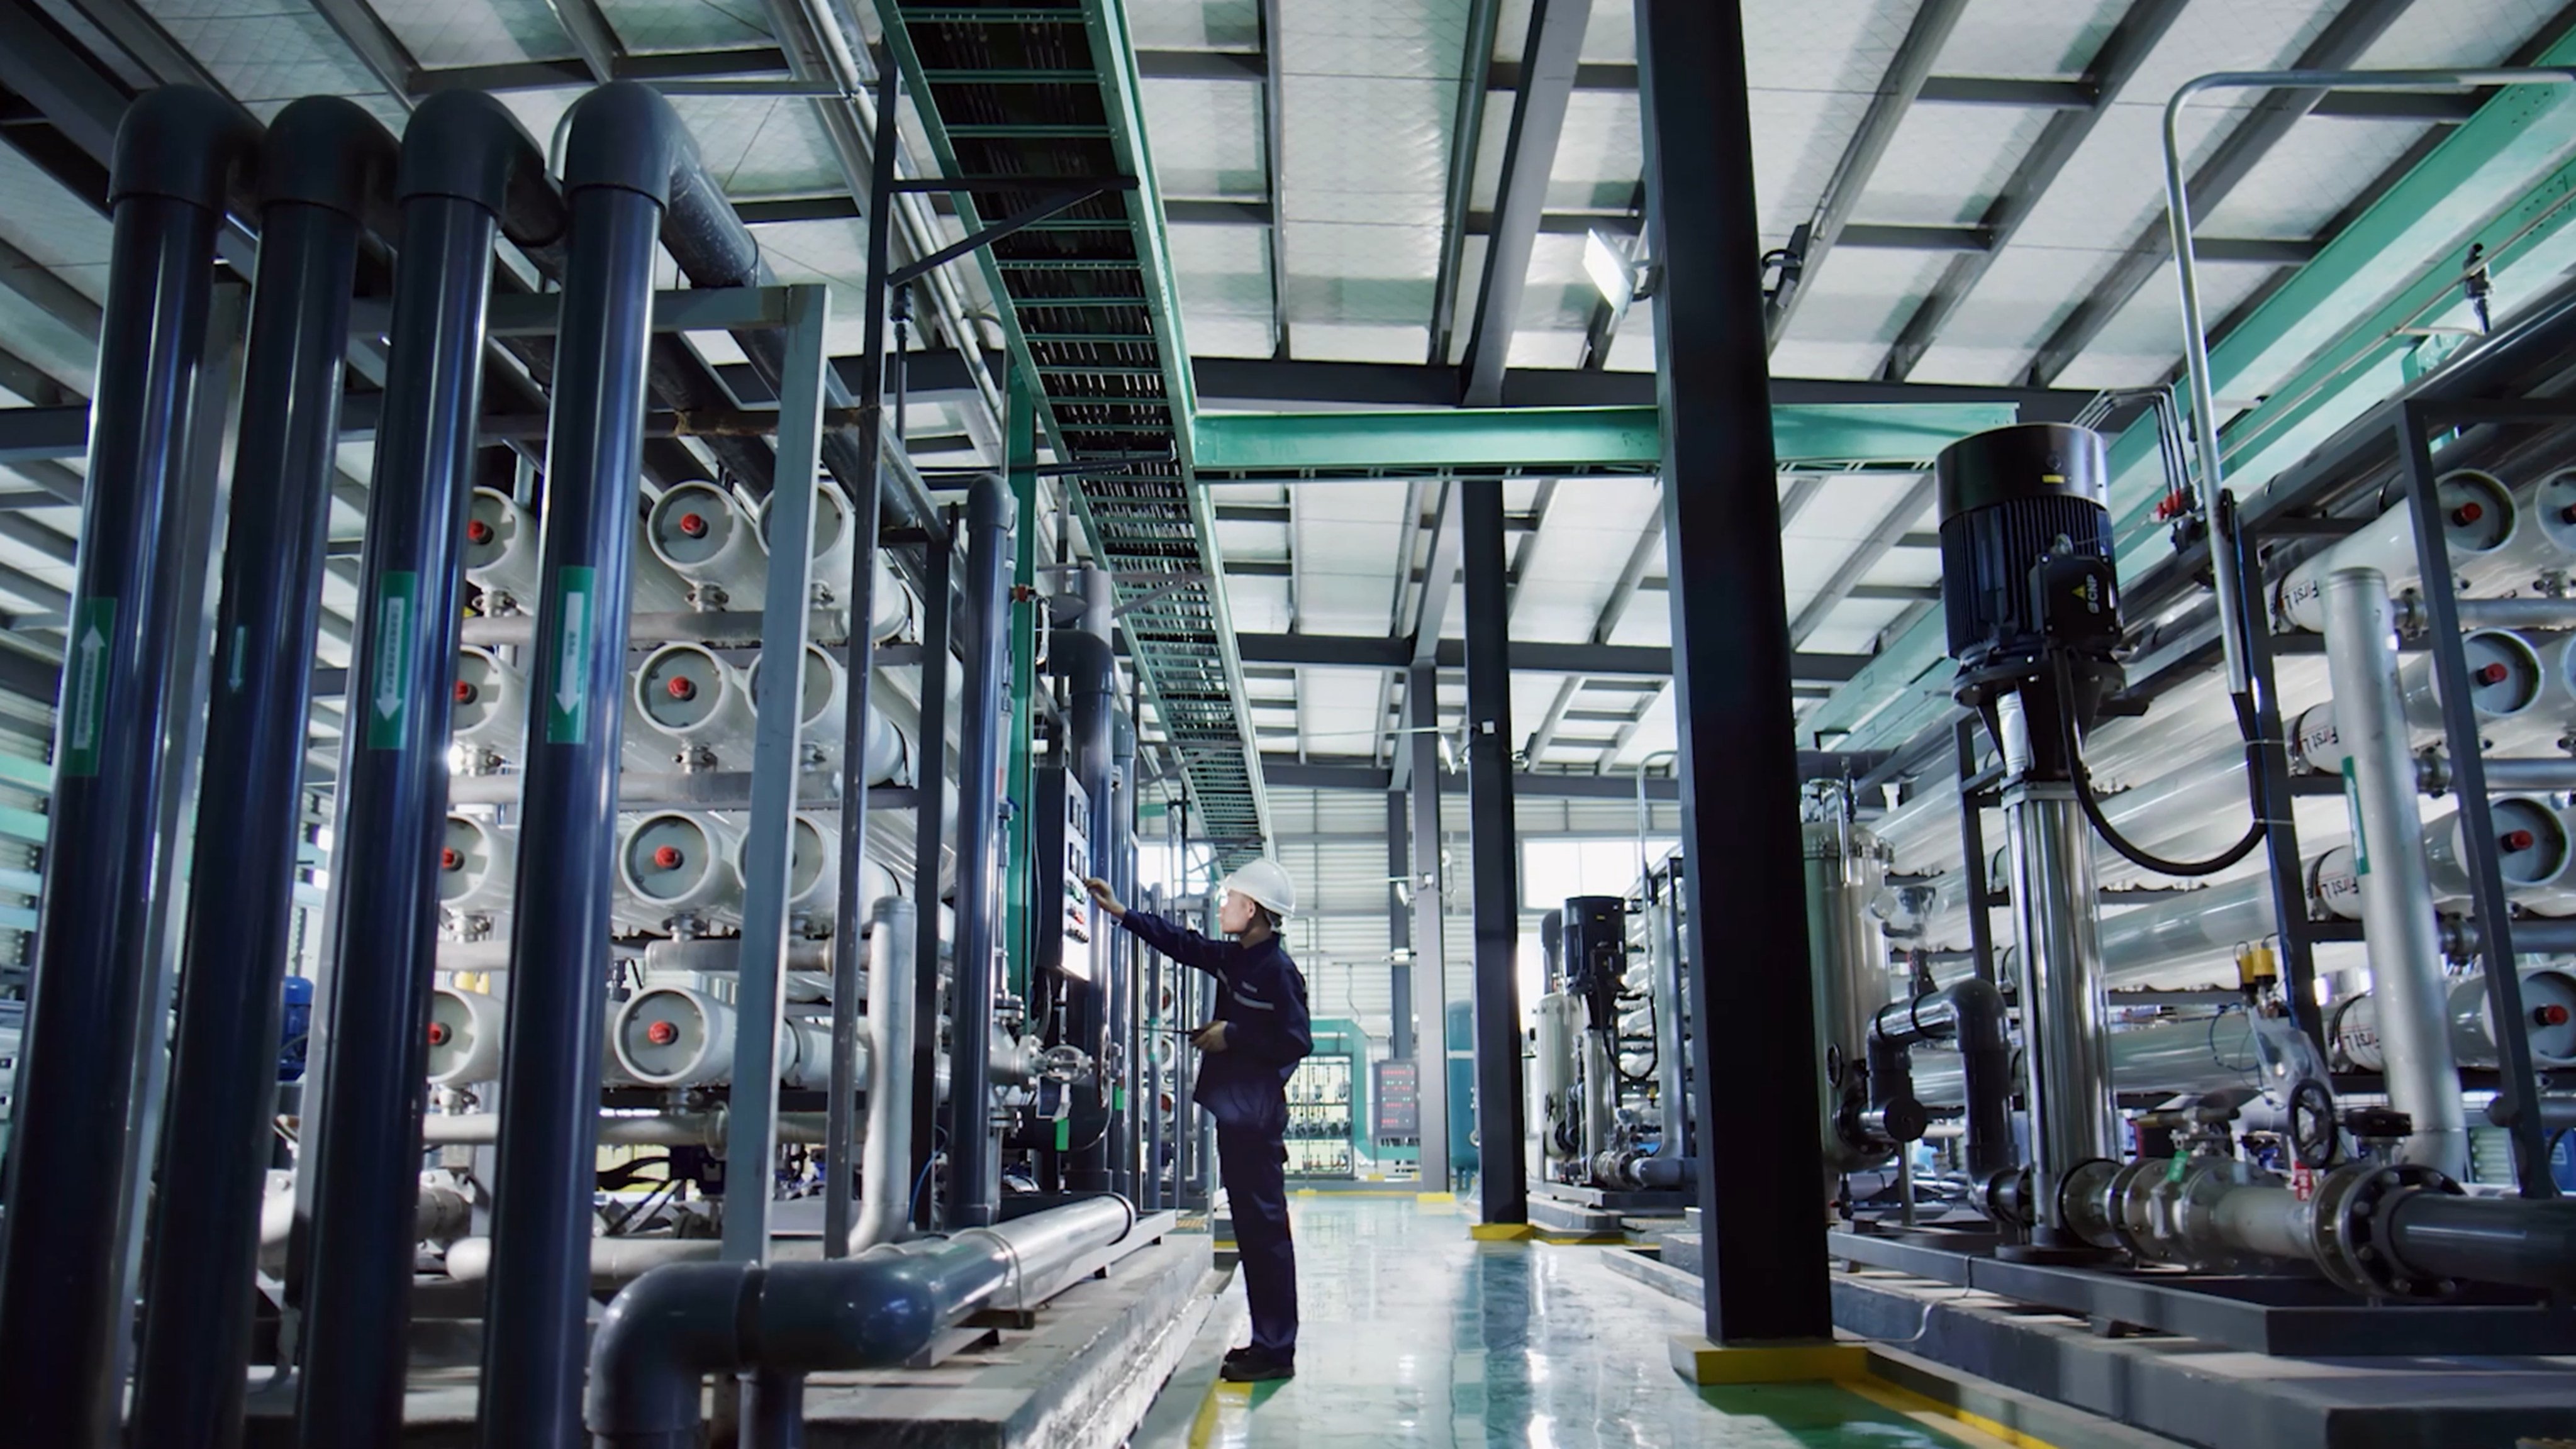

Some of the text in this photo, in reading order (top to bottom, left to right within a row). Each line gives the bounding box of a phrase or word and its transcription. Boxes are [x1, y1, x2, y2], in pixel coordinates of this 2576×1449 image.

[2087, 574, 2097, 601] CNP
[2294, 580, 2319, 606] First
[2312, 726, 2339, 750] First
[2331, 877, 2359, 897] First
